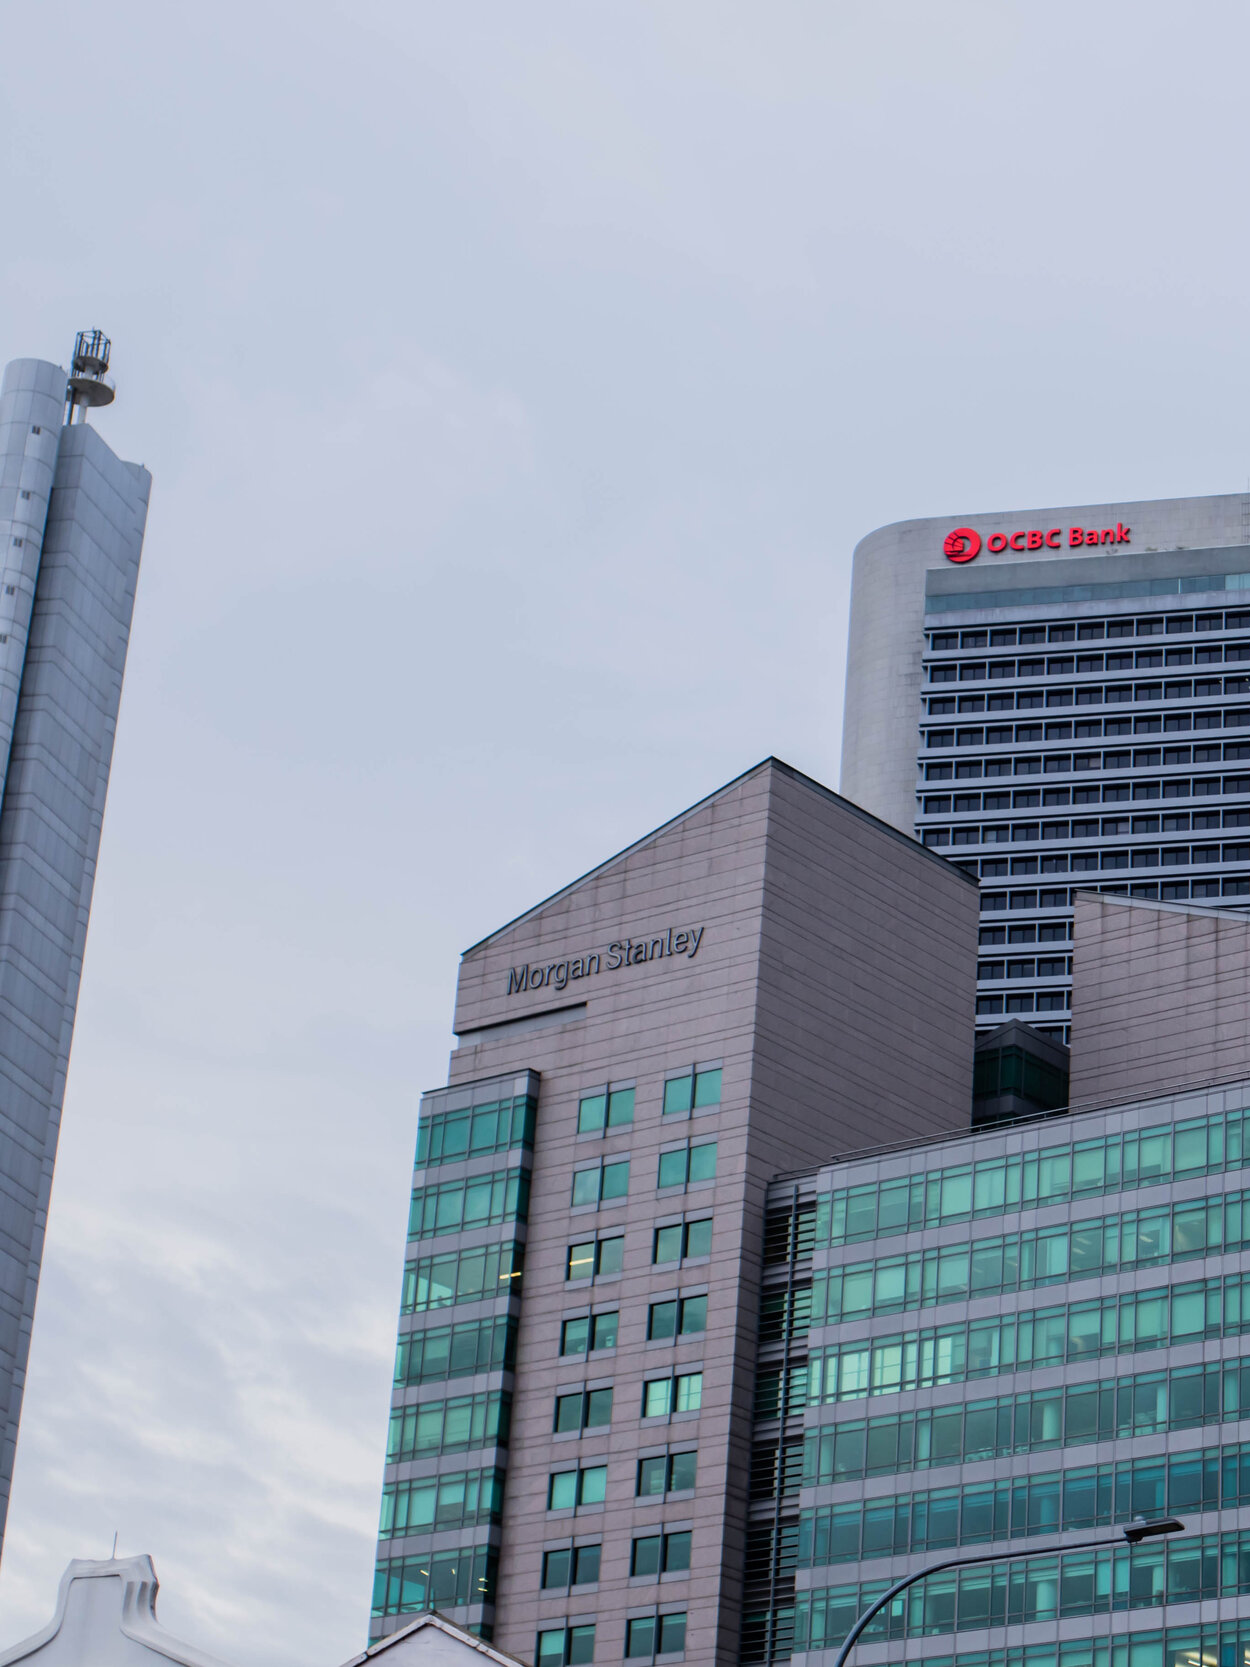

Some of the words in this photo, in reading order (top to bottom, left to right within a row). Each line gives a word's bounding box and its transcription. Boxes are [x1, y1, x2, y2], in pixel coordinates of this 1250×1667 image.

[987, 528, 1061, 553] OCBC
[1069, 522, 1131, 546] Bank
[506, 952, 601, 995] Morgan
[606, 927, 705, 969] Stanley
